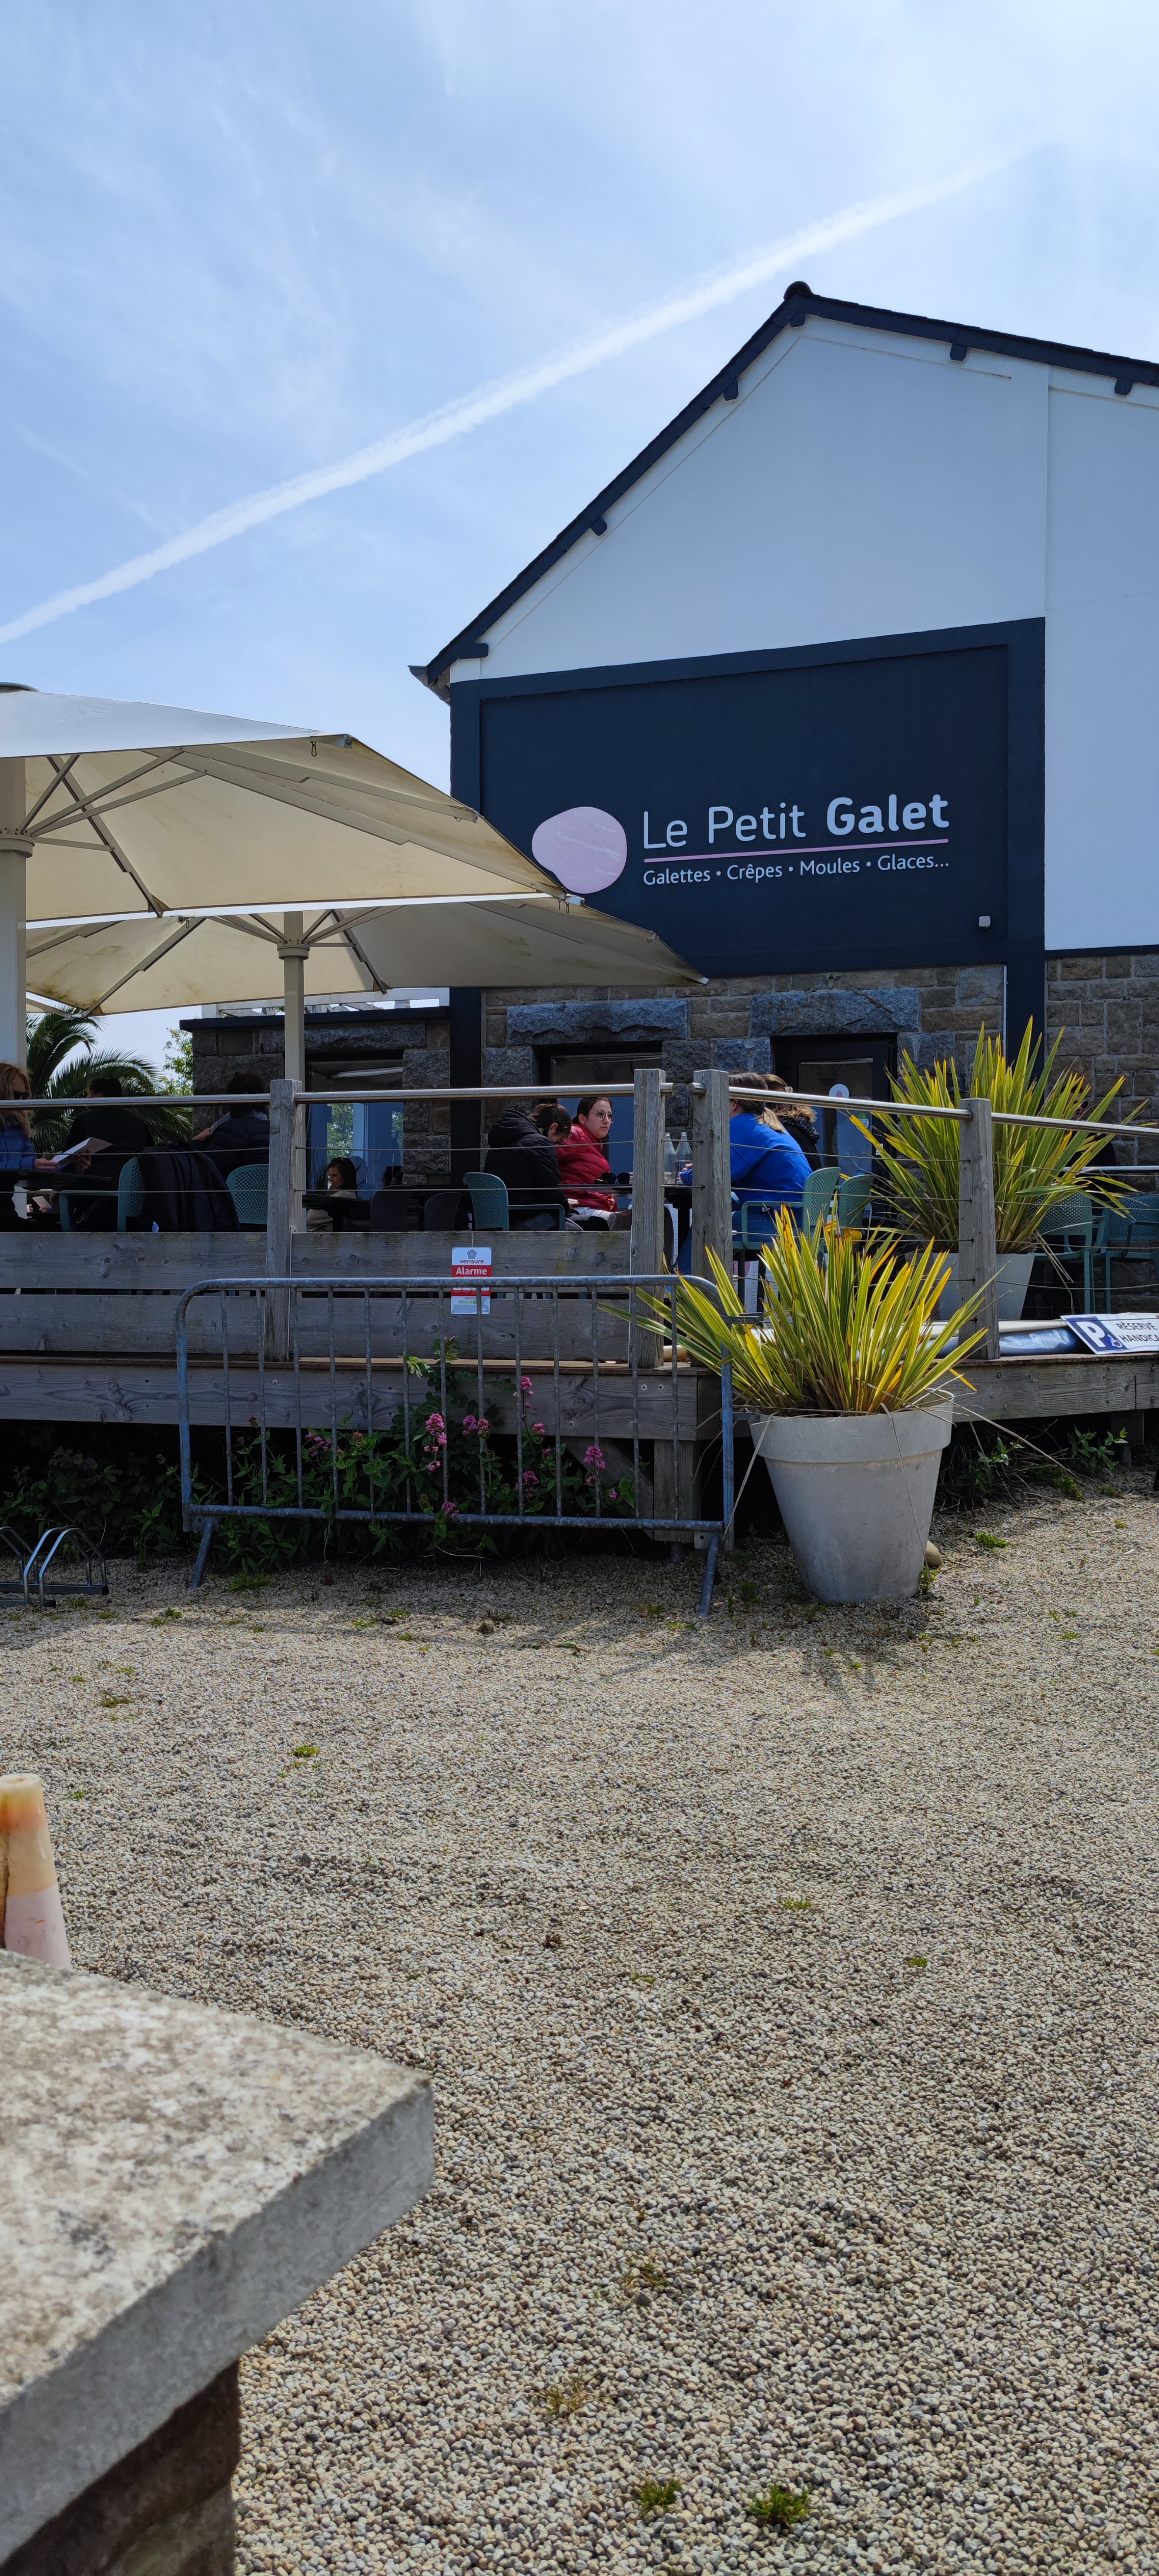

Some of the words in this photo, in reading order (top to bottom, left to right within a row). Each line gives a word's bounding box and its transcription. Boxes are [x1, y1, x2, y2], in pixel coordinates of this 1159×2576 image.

[643, 811, 687, 849] Le
[708, 802, 806, 844] Petit
[827, 794, 950, 835] Galet
[643, 868, 711, 885] Galettes
[727, 863, 782, 883] Crêpes
[800, 857, 860, 875] Moules
[456, 1267, 487, 1275] Alarme
[1076, 1322, 1106, 1347] P
[1115, 1322, 1158, 1330] RÉSERVÉ
